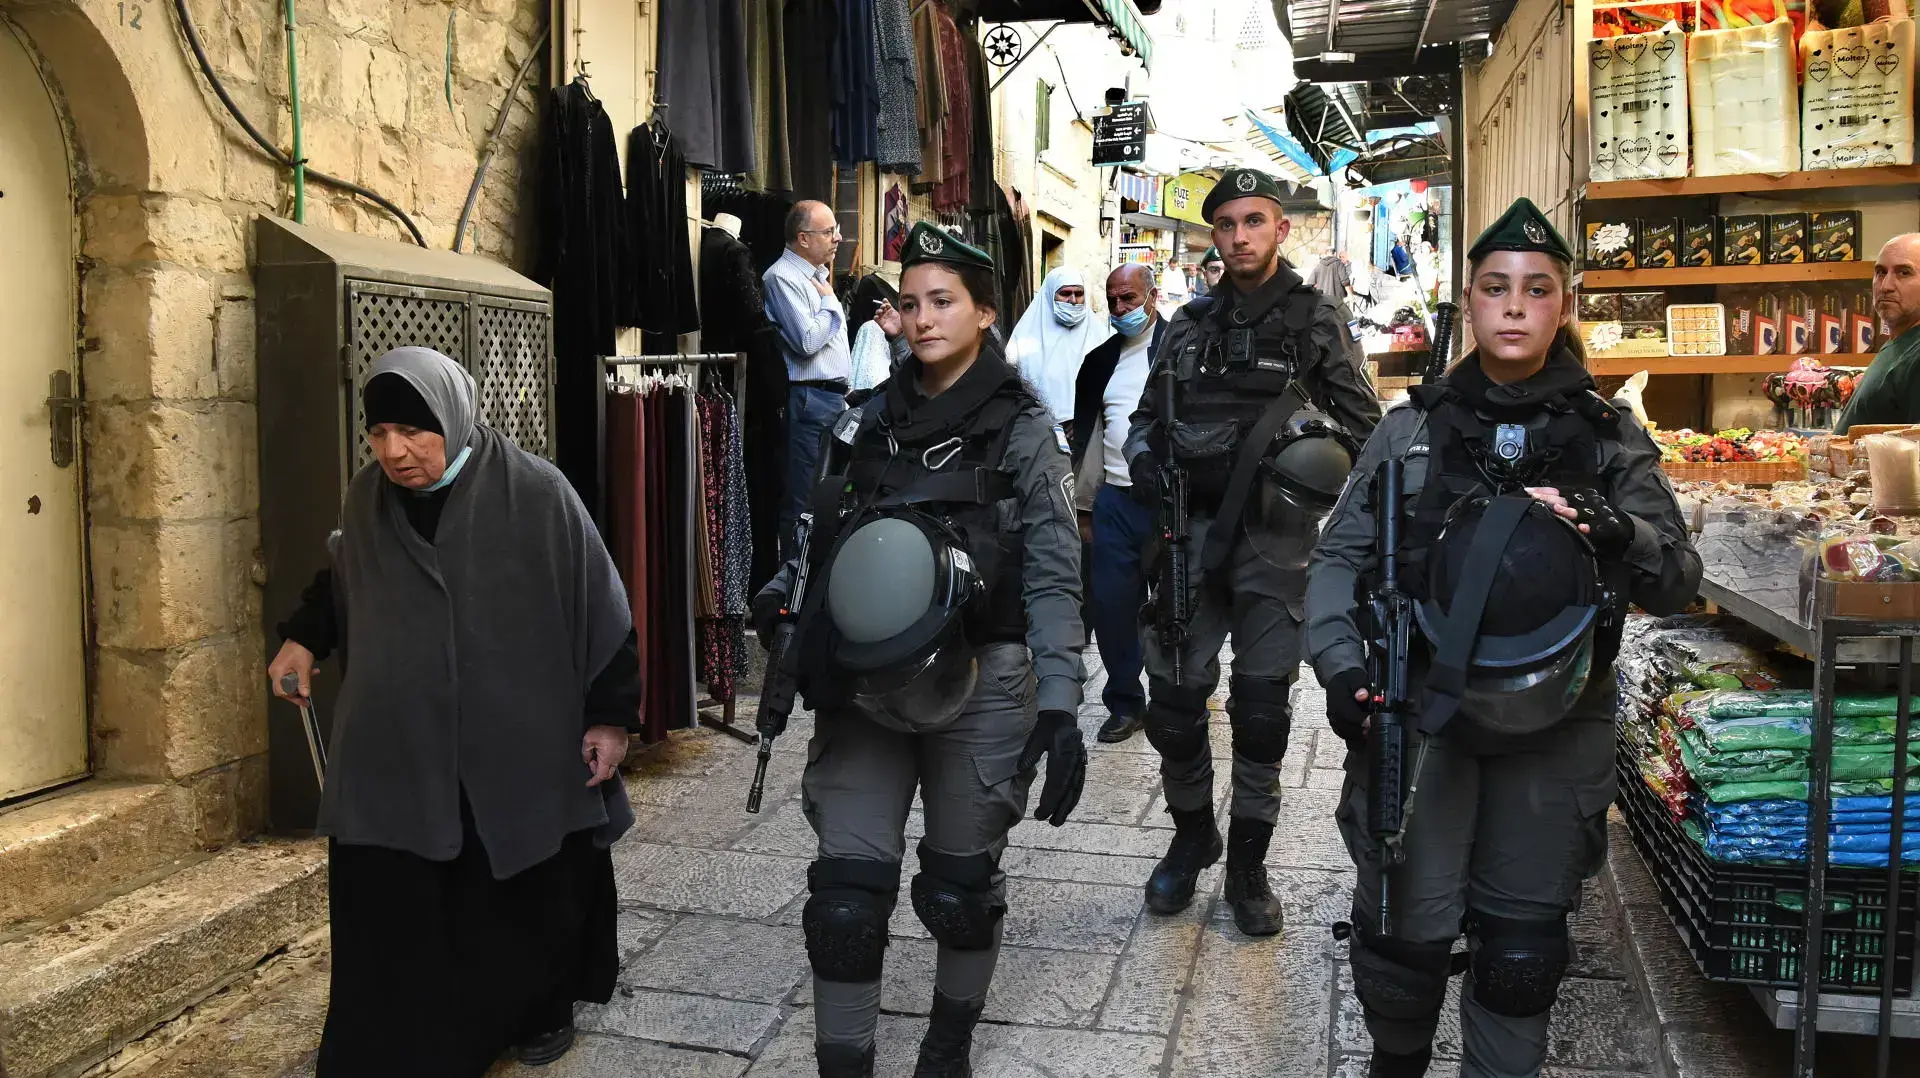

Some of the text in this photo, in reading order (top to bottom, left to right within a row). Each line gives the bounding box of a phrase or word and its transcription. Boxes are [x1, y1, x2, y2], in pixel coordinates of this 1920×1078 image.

[117, 2, 142, 30] 12
[1618, 43, 1644, 51] Moltex
[1837, 54, 1866, 63] Moltex
[1622, 146, 1648, 154] Moltex
[1174, 187, 1189, 200] FUZE
[1174, 198, 1185, 209] tea
[1602, 229, 1622, 245] 35
